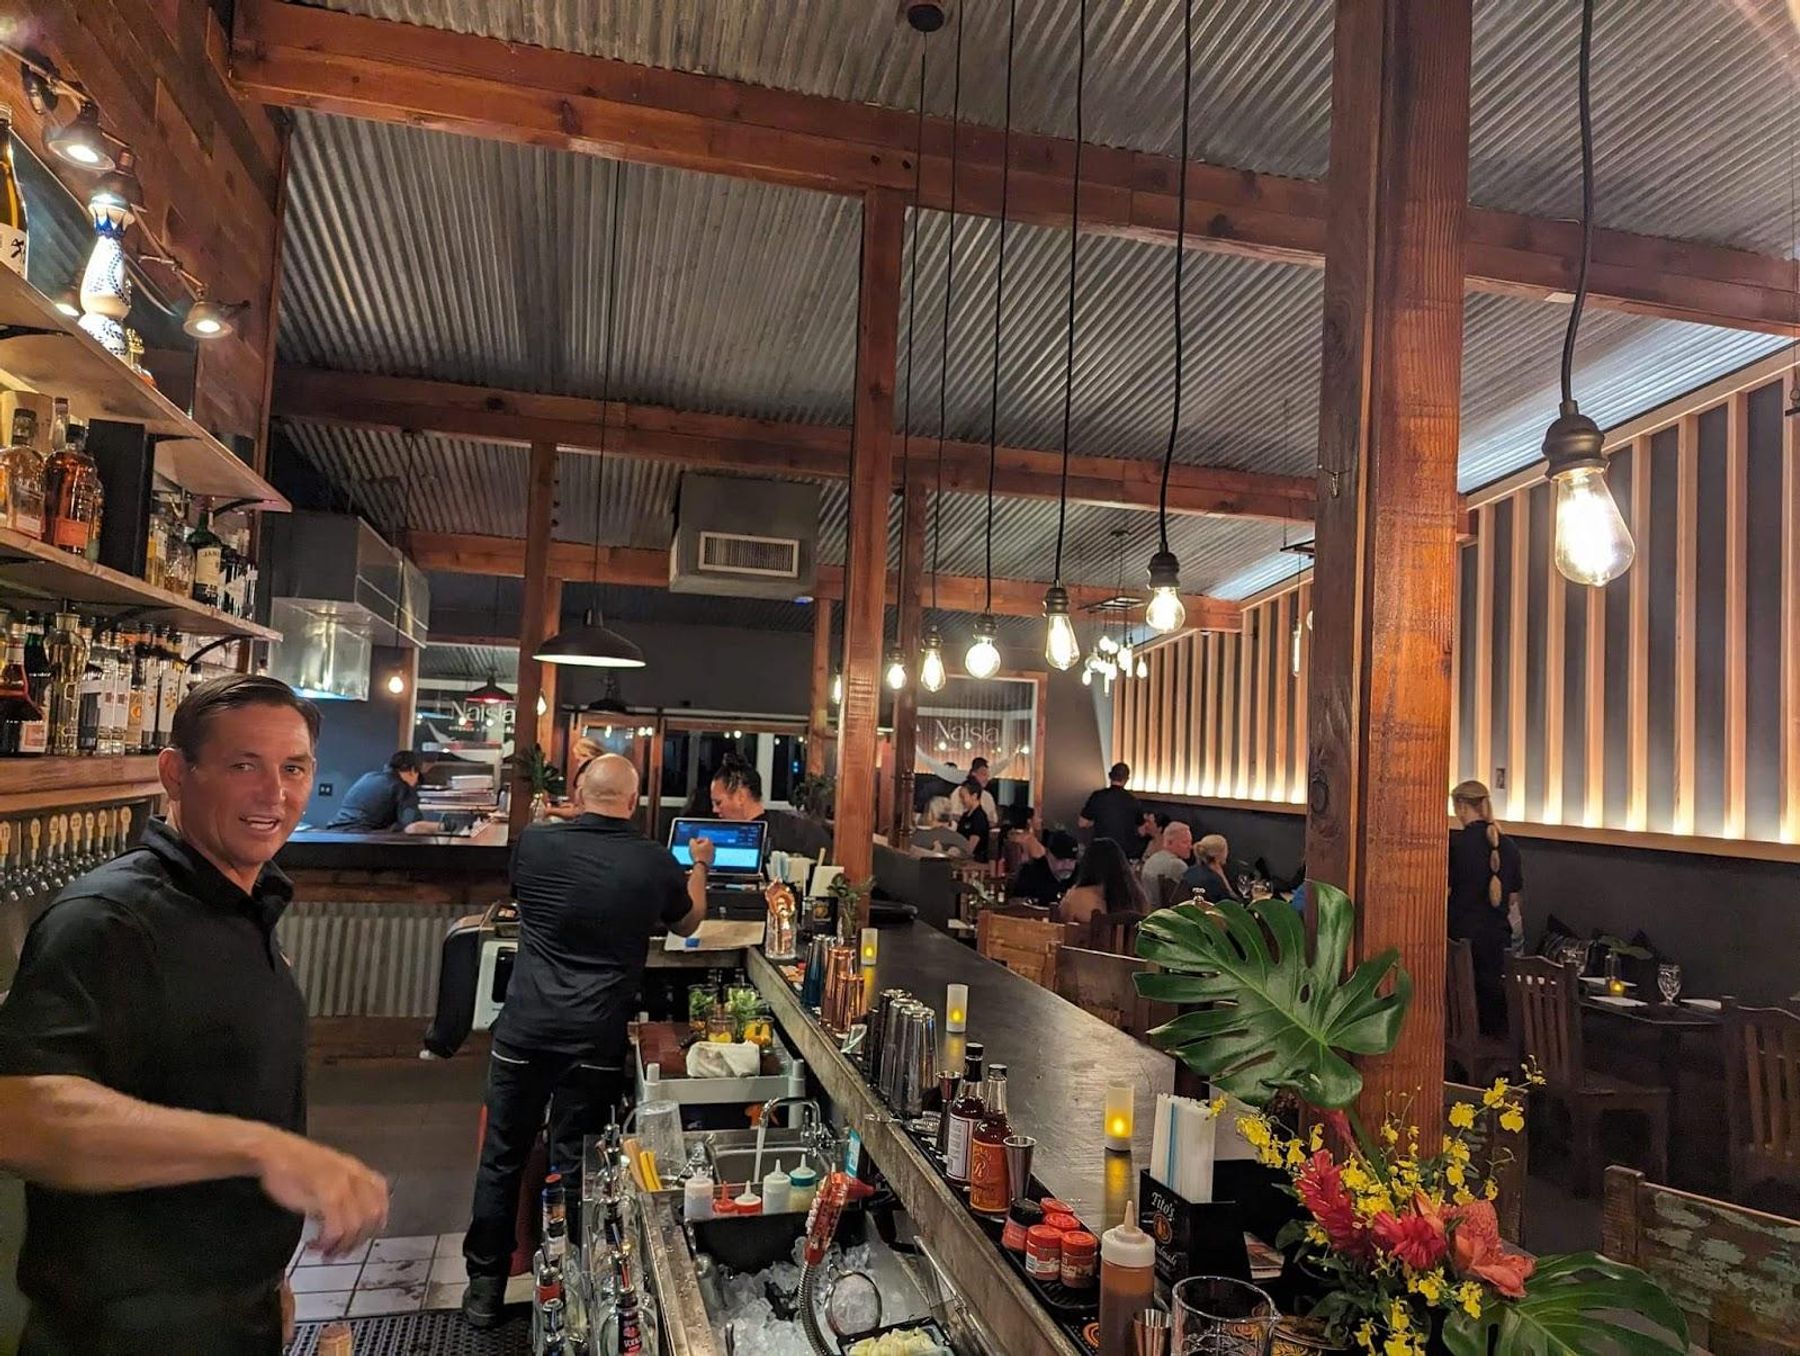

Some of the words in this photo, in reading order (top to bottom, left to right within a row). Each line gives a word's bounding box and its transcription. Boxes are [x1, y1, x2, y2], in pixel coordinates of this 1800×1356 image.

[452, 700, 516, 724] Naisla
[935, 719, 999, 745] Naisla
[1151, 1191, 1175, 1219] Tito's
